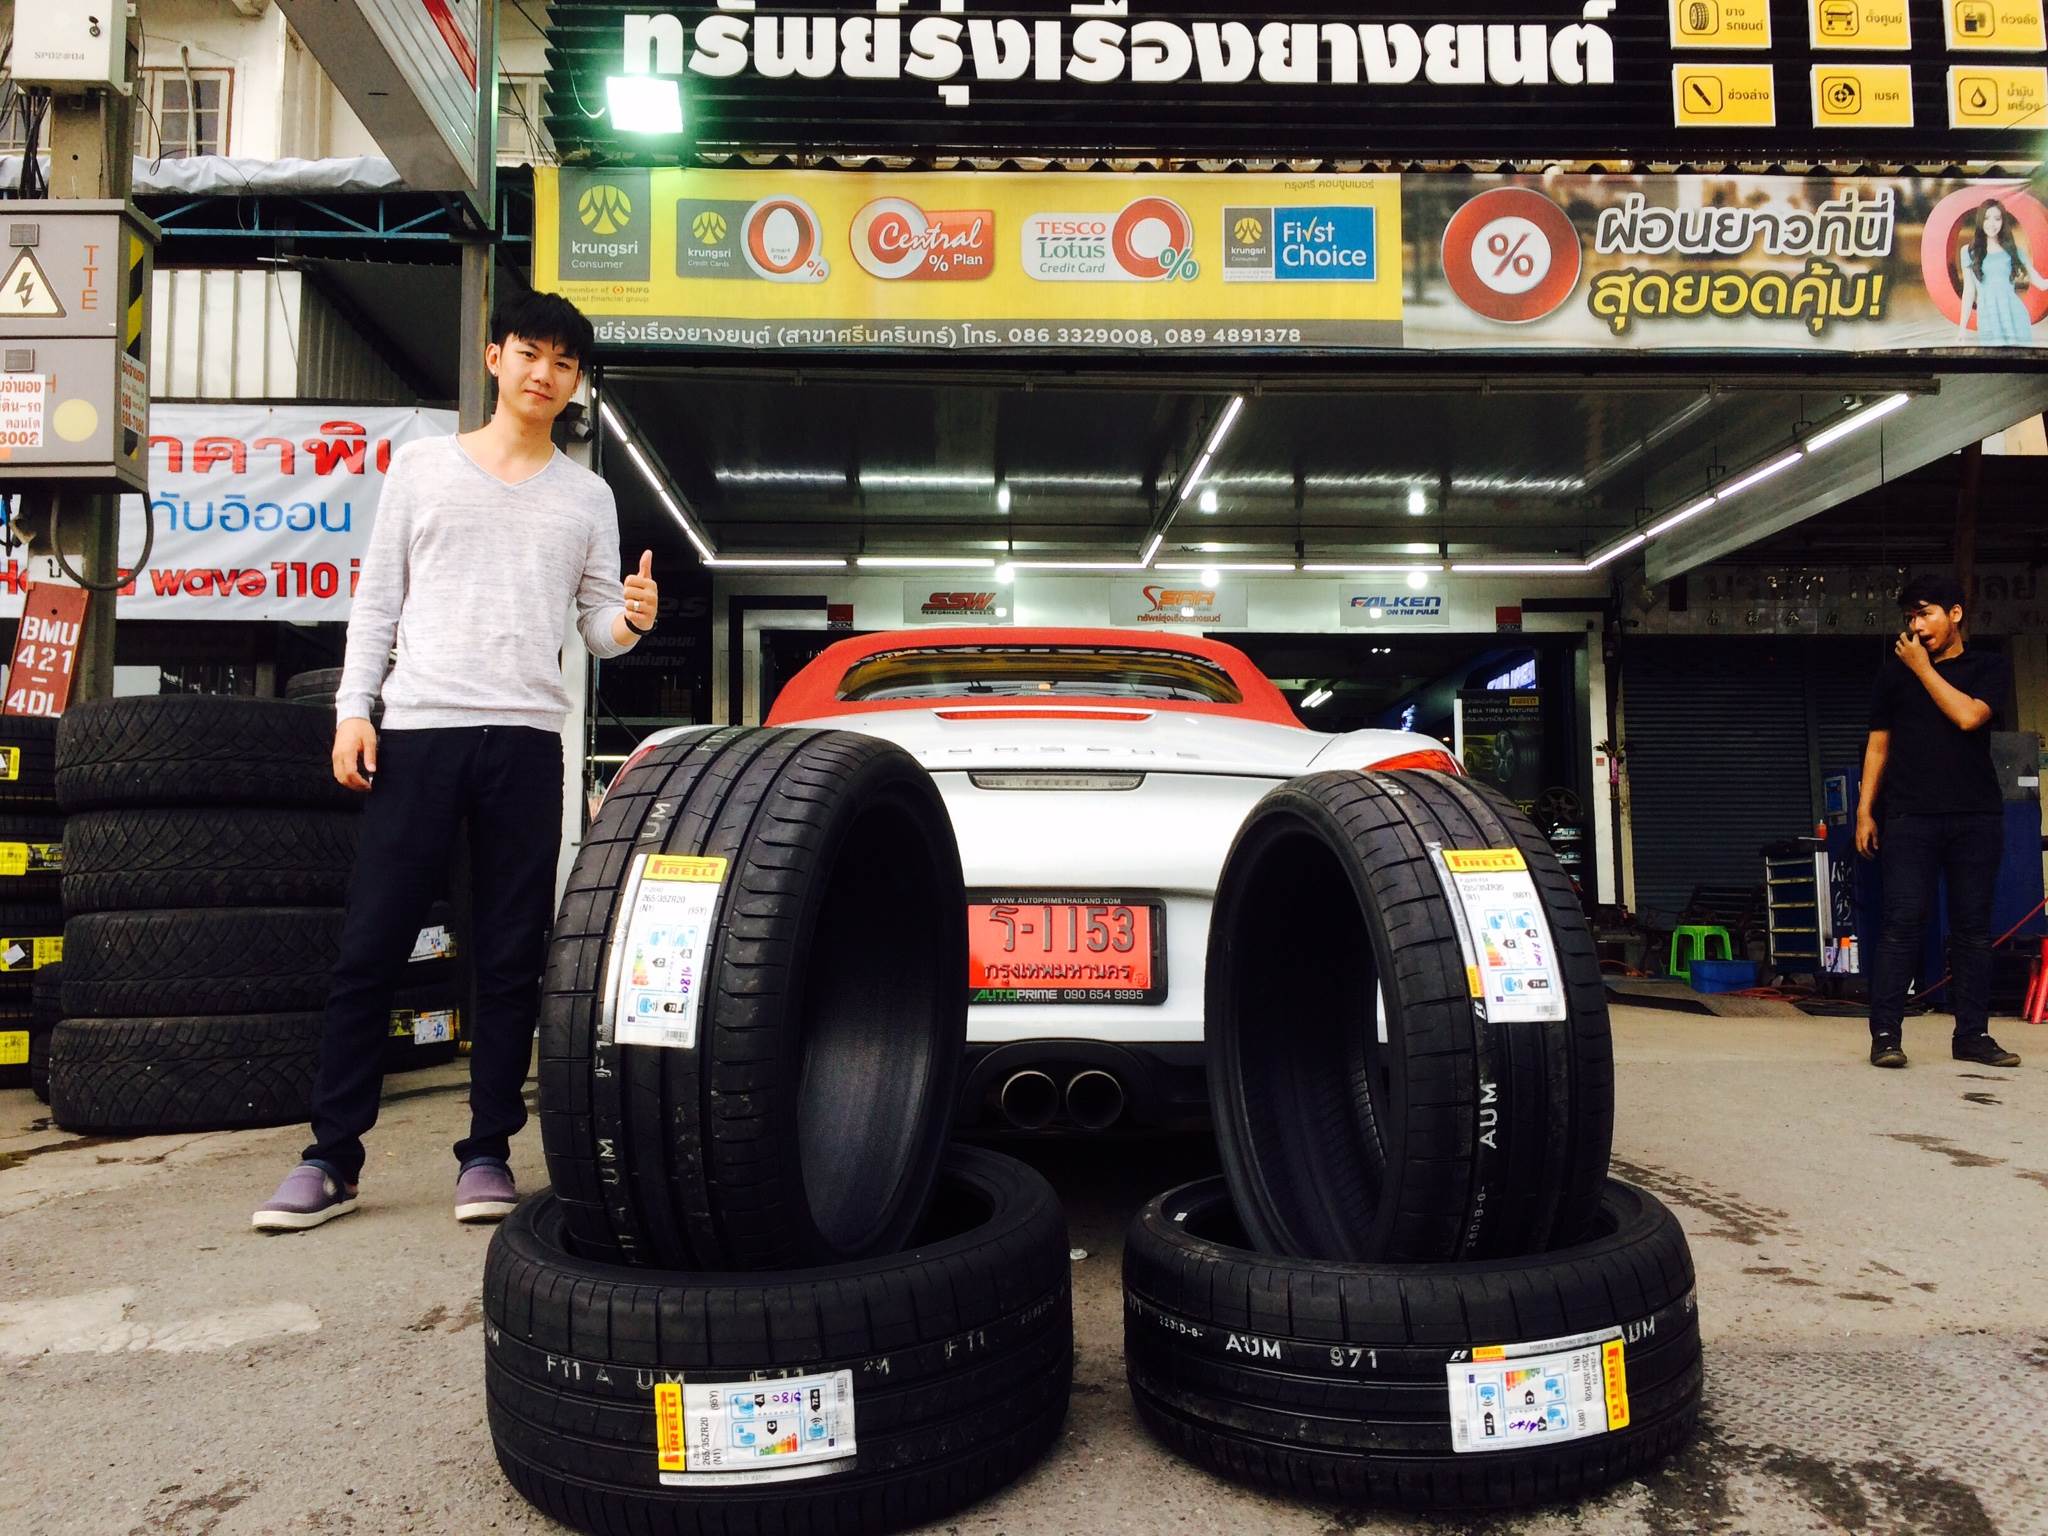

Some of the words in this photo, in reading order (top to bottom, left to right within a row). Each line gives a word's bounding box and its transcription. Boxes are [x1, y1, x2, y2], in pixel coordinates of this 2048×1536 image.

[1725, 7, 1746, 17] ยาง
[1726, 18, 1764, 32] รถยนต์
[1728, 85, 1770, 102] ช่วงล่าง
[1874, 90, 1900, 102] เบรค
[1036, 221, 1106, 235] TESCO
[1598, 188, 1893, 253] ผ่อนยาวที่นี่
[879, 217, 984, 251] Central
[571, 240, 638, 257] krungsri
[688, 248, 731, 258] krungsri
[1039, 241, 1106, 259] Lotus
[1231, 246, 1266, 256] krungsri
[1282, 244, 1367, 267] Choice
[571, 259, 624, 269] Consumer
[953, 253, 983, 265] Plan
[1040, 262, 1076, 273] Credit
[1078, 262, 1105, 273] Card
[1594, 266, 1885, 332] สุดยอดคุ้ม!
[961, 323, 1002, 345] โทร.
[1008, 327, 1050, 343] 086
[1056, 327, 1159, 346] 3329008,
[1164, 327, 1206, 344] 089
[1212, 327, 1301, 344] 4891378
[921, 592, 998, 611] SSW
[1351, 596, 1441, 608] FALKEN
[1400, 608, 1413, 616] THE
[1415, 608, 1440, 616] PULSE
[21, 616, 79, 646] BMU
[16, 644, 73, 674] 421
[7, 688, 62, 719] 4DL
[652, 859, 720, 877] PIRELLI
[1451, 853, 1517, 868] PIRELLI
[984, 963, 1131, 987] กรุงเทพมหานคร
[973, 989, 1058, 1002] AUTOPRIME
[1064, 990, 1087, 1000] 090
[1089, 990, 1111, 1000] 654
[1114, 990, 1144, 1000] 9995
[1480, 1083, 1498, 1149] AUM
[1225, 1333, 1282, 1360] AUM
[1329, 1346, 1378, 1369] 971
[547, 1354, 581, 1381] F11
[1607, 1346, 1625, 1421] PIRELLI
[663, 1391, 680, 1463] PIRELLI
[702, 1416, 711, 1466] 265/35ZR20
